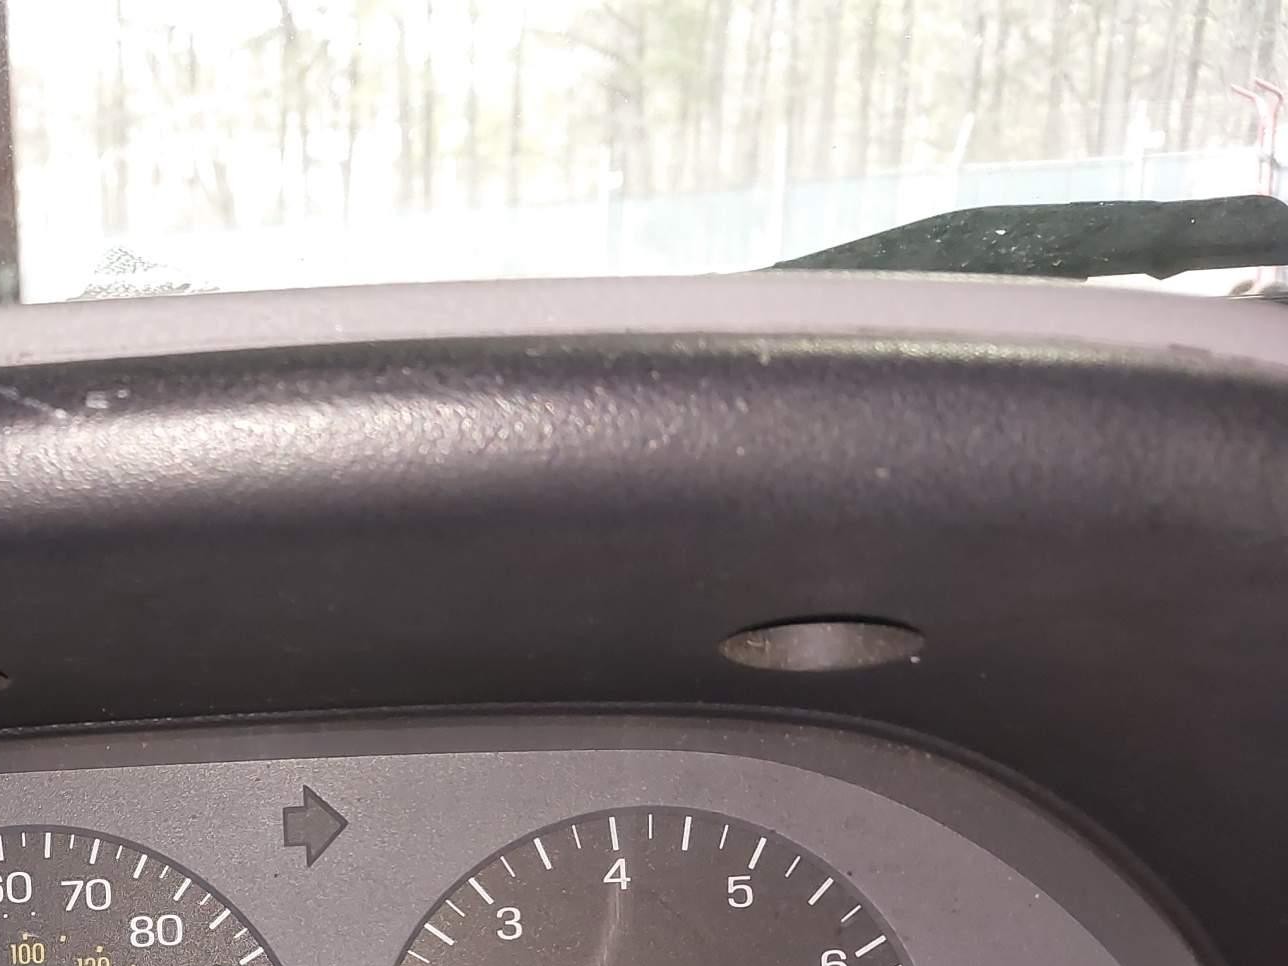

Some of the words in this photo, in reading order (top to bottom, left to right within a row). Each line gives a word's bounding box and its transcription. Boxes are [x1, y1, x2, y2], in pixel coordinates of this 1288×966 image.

[602, 858, 631, 889] 4
[61, 878, 112, 911] 70
[727, 876, 753, 907] 5
[129, 915, 184, 948] 80
[496, 908, 523, 940] 3
[11, 943, 45, 965] 100
